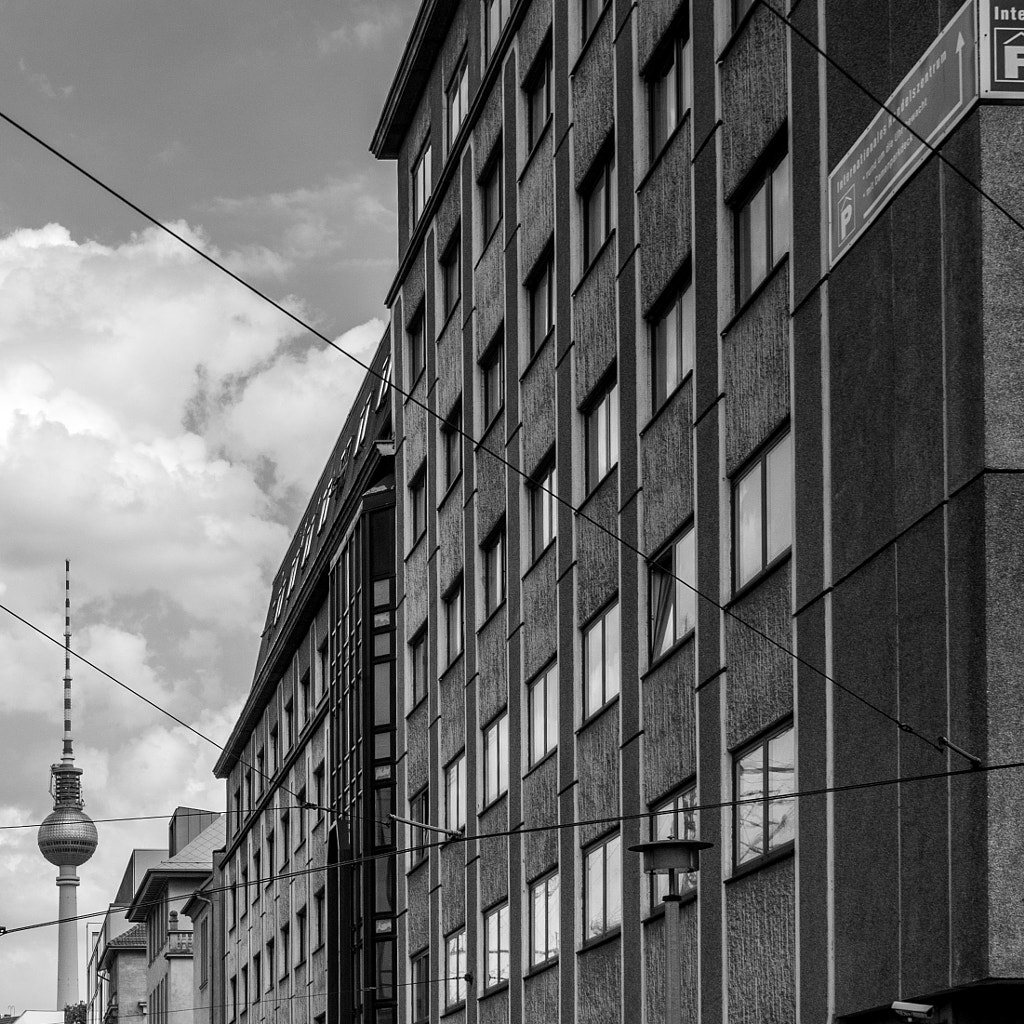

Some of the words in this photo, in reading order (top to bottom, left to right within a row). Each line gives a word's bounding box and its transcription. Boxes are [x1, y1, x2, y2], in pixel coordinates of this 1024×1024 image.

[837, 124, 887, 193] Internationales
[888, 50, 947, 129] Handelszentrum
[841, 204, 852, 240] P
